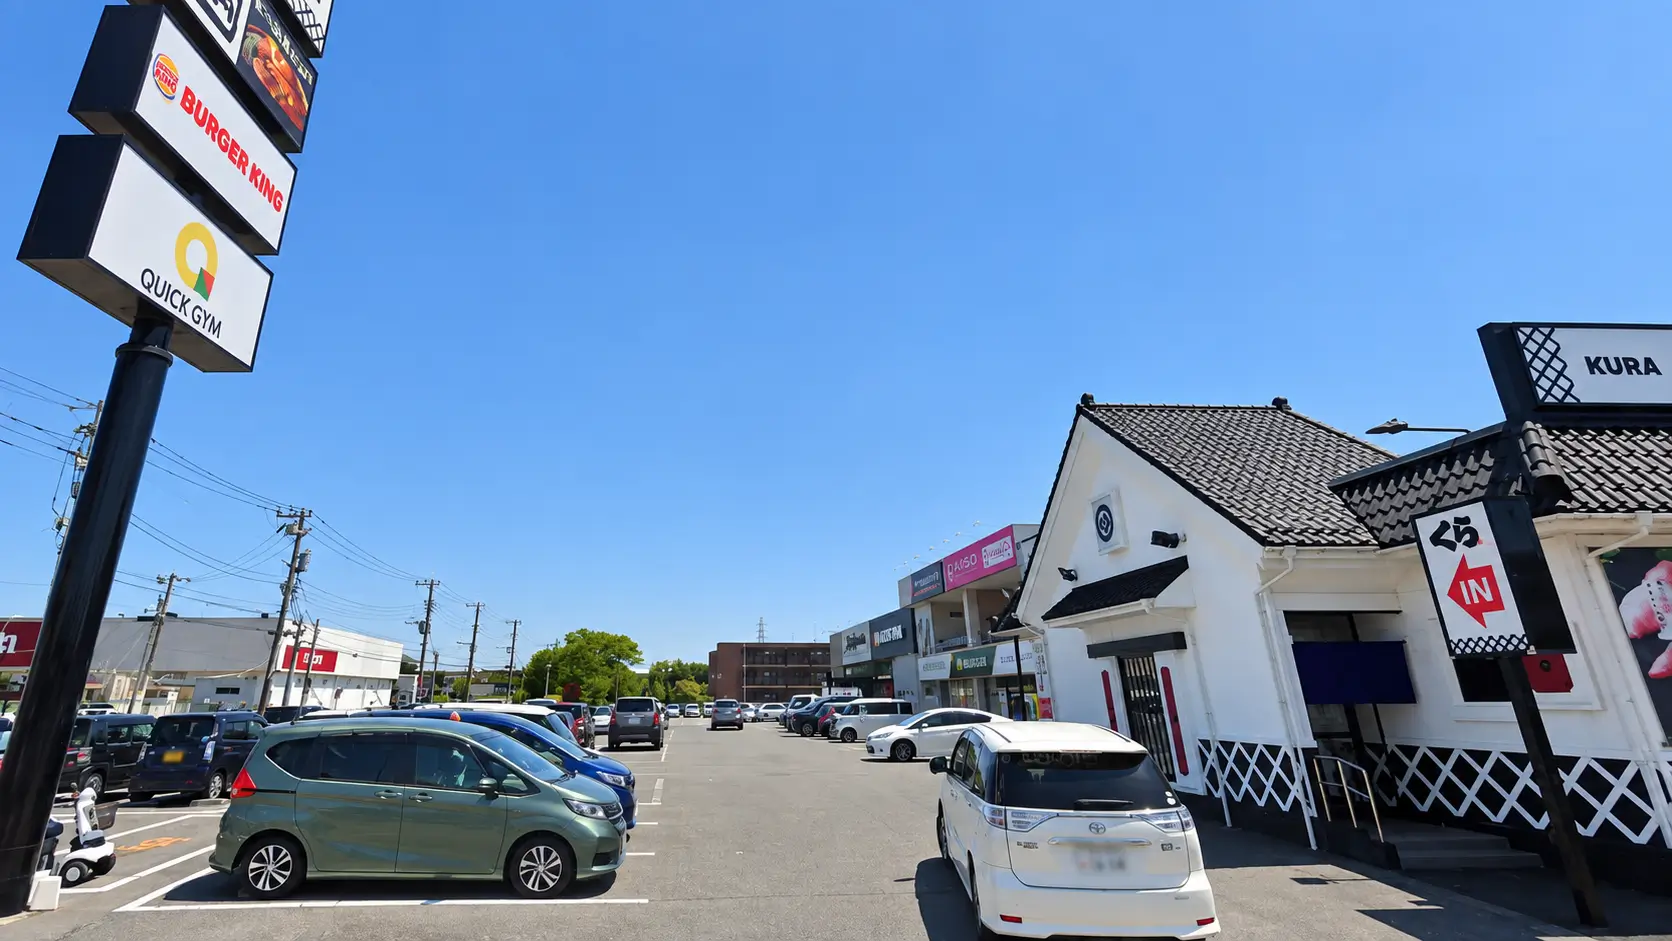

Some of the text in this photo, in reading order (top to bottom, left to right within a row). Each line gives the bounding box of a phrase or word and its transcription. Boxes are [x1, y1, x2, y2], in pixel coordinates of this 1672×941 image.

[179, 86, 249, 175] BURGER
[248, 163, 283, 213] KING
[140, 268, 222, 339] QUICK GYM
[1583, 355, 1663, 376] KURA
[1429, 515, 1479, 552] くら
[1459, 576, 1494, 605] IN
